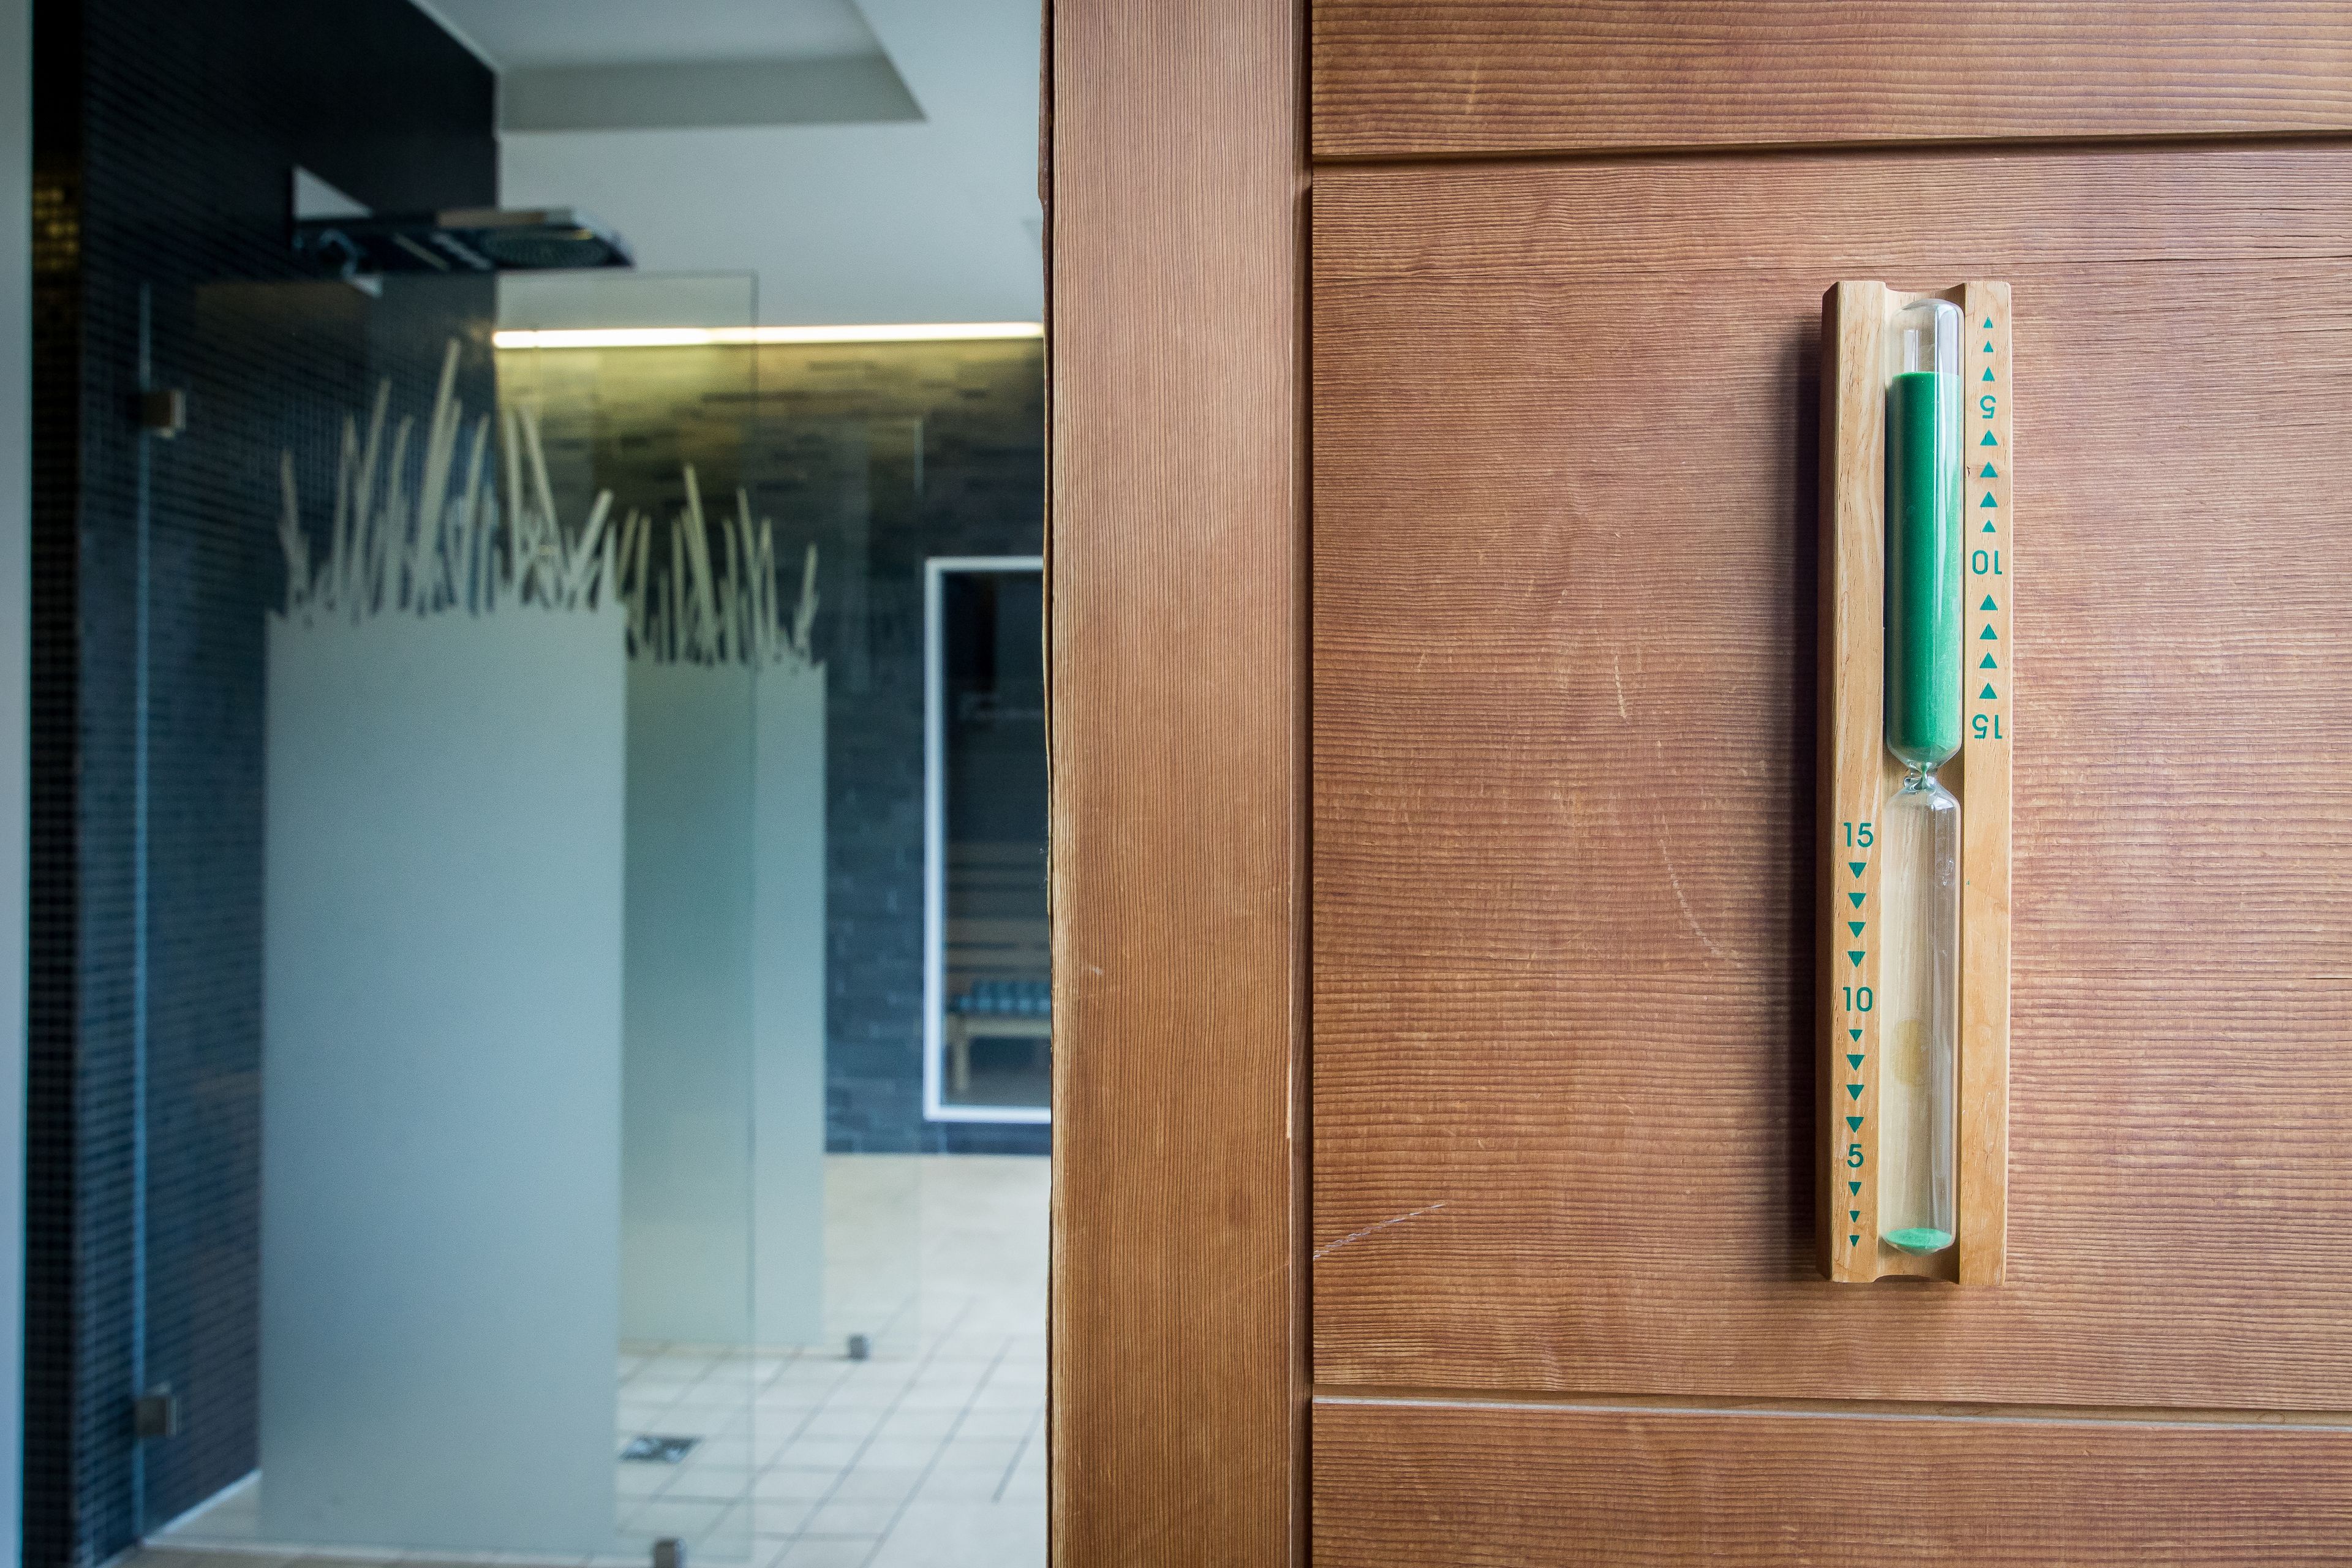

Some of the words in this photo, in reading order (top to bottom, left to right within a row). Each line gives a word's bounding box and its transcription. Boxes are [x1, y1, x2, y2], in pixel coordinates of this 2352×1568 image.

[1980, 395, 1996, 419] 5
[1972, 549, 2003, 575] 10
[1972, 714, 2002, 739] 15
[1843, 821, 1874, 848] 15
[1842, 987, 1873, 1012] 10
[1847, 1144, 1863, 1168] 5
